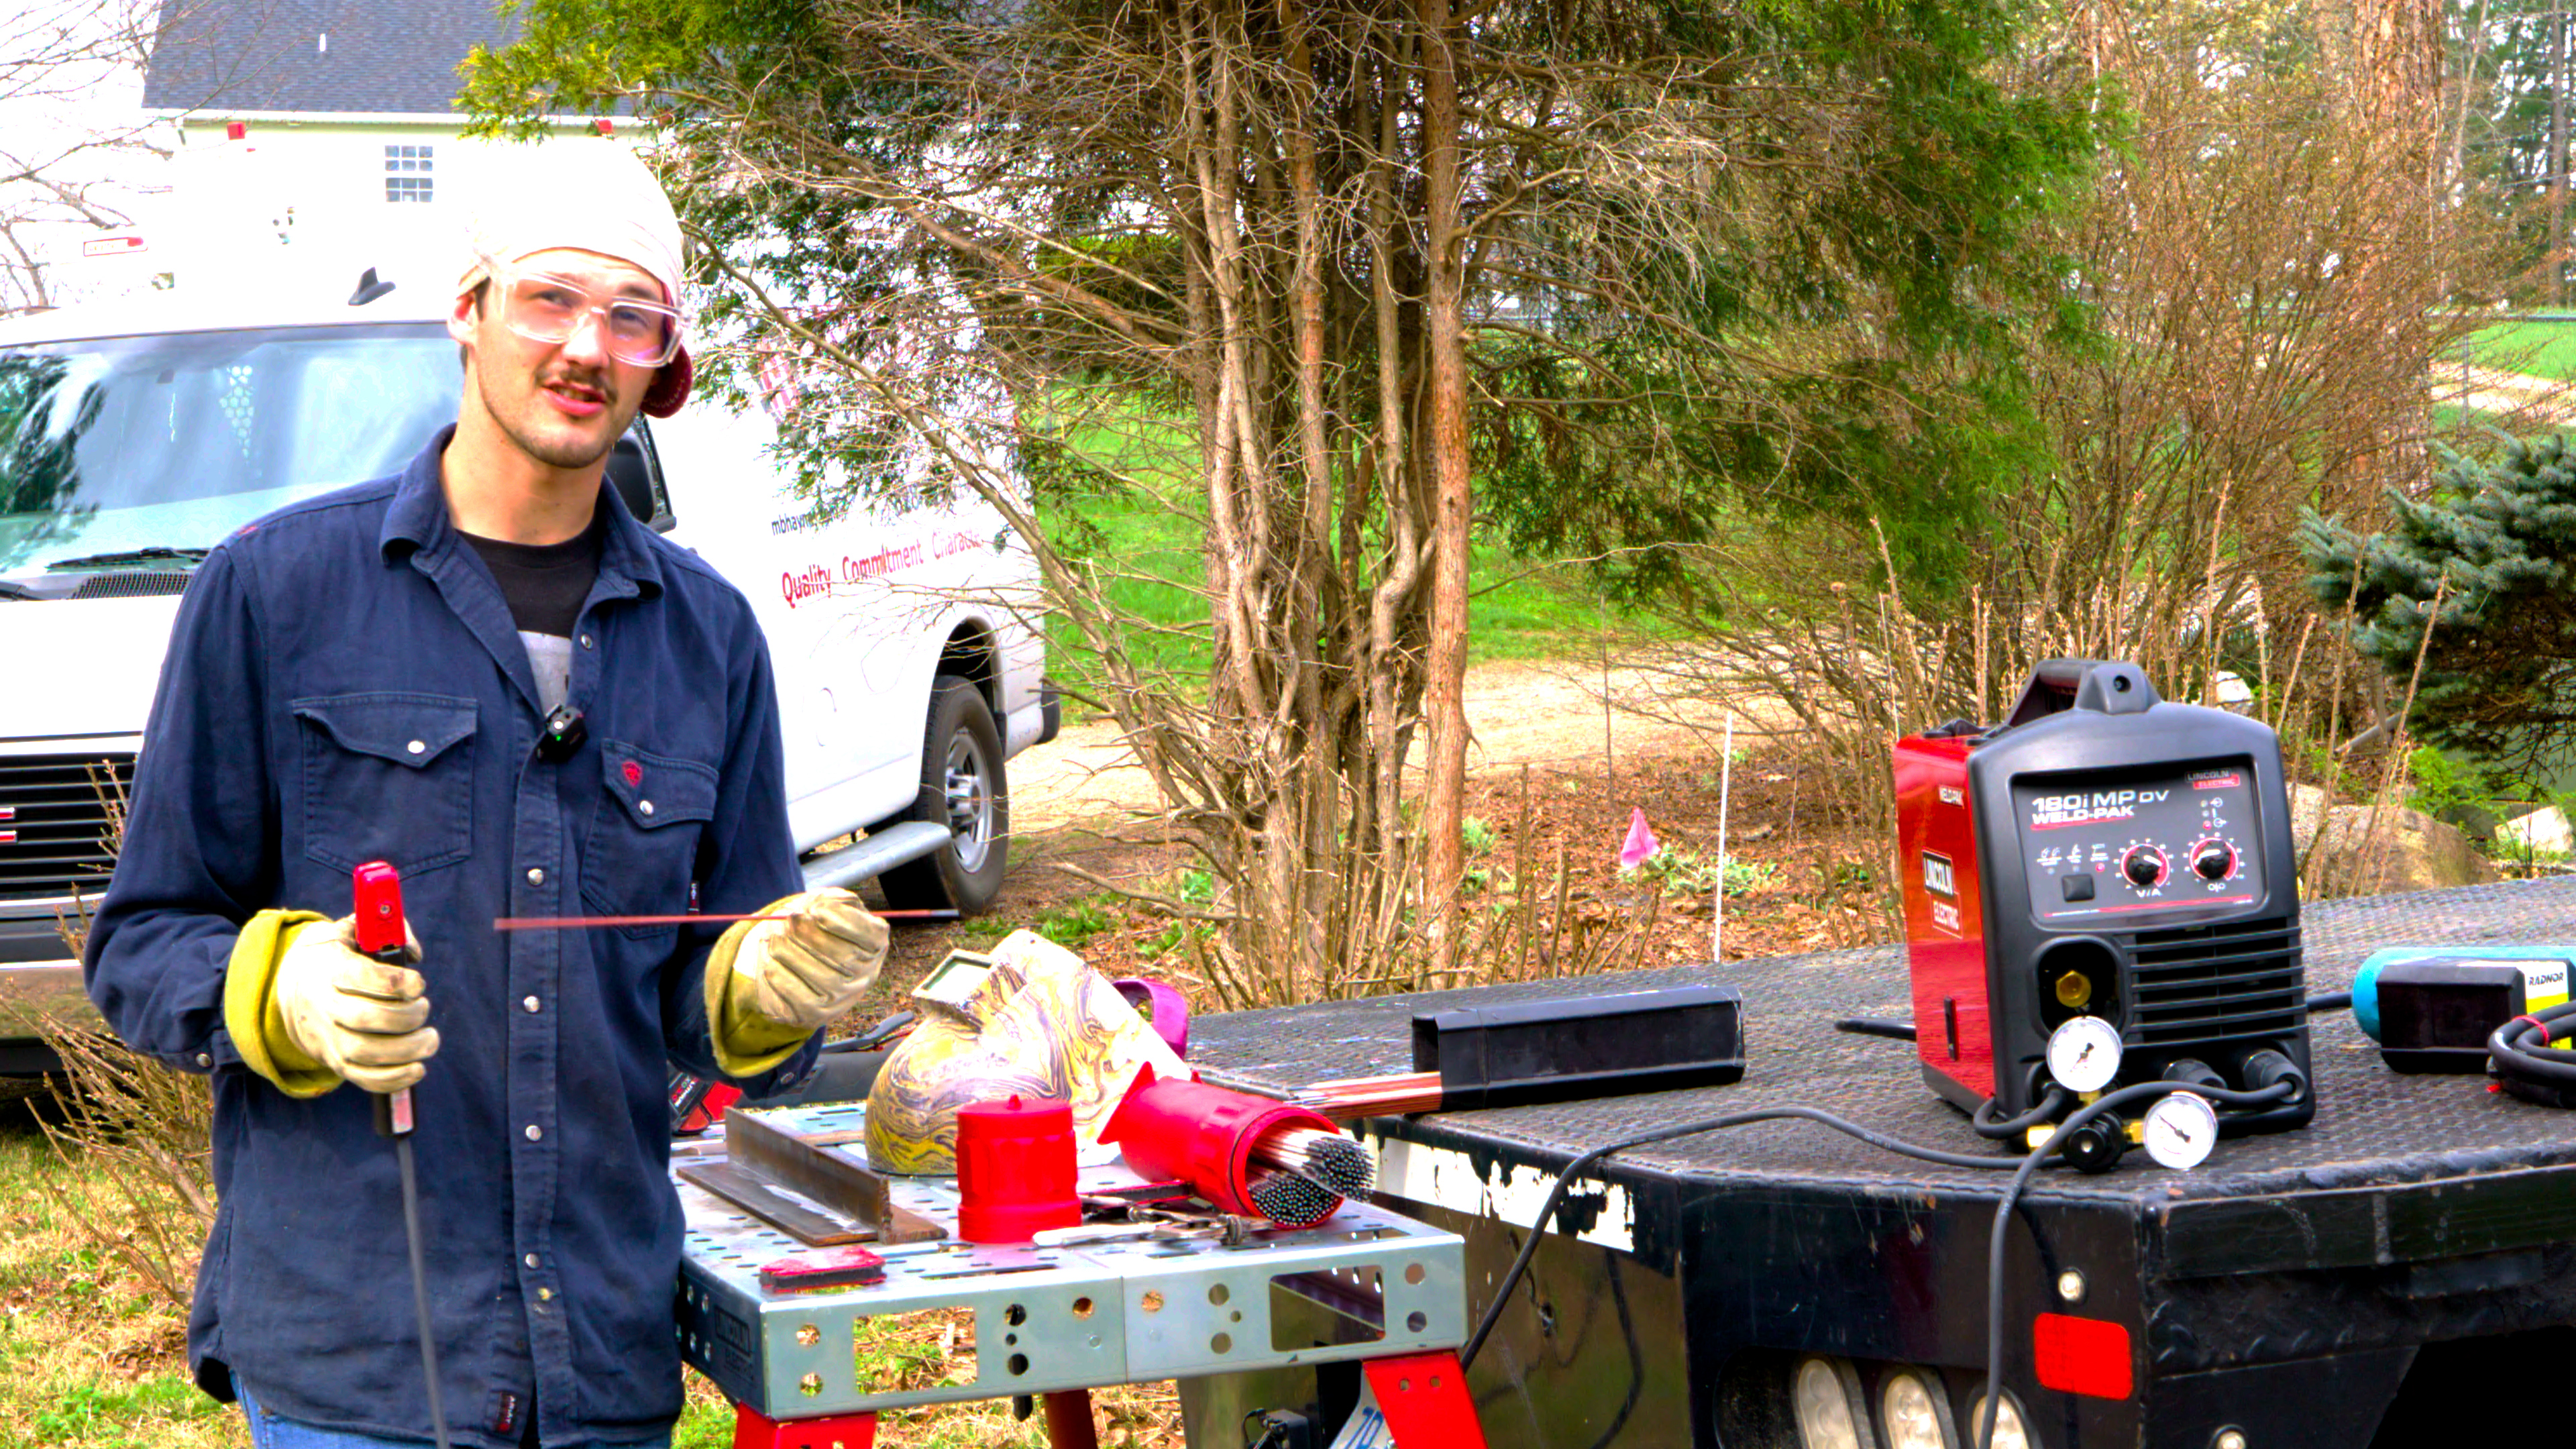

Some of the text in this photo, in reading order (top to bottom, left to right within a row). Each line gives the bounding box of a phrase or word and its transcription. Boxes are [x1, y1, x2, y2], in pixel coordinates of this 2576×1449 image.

[782, 564, 830, 609] Quality
[843, 539, 924, 584] Commitment
[2187, 769, 2230, 782] LINCOLN
[2032, 790, 2169, 812] 180i MP DV
[2032, 805, 2135, 824] WELD-PAK
[1923, 857, 1953, 896] LINCOLN
[1933, 900, 1959, 930] ELECTRIC
[2528, 971, 2564, 986] RADNOR
